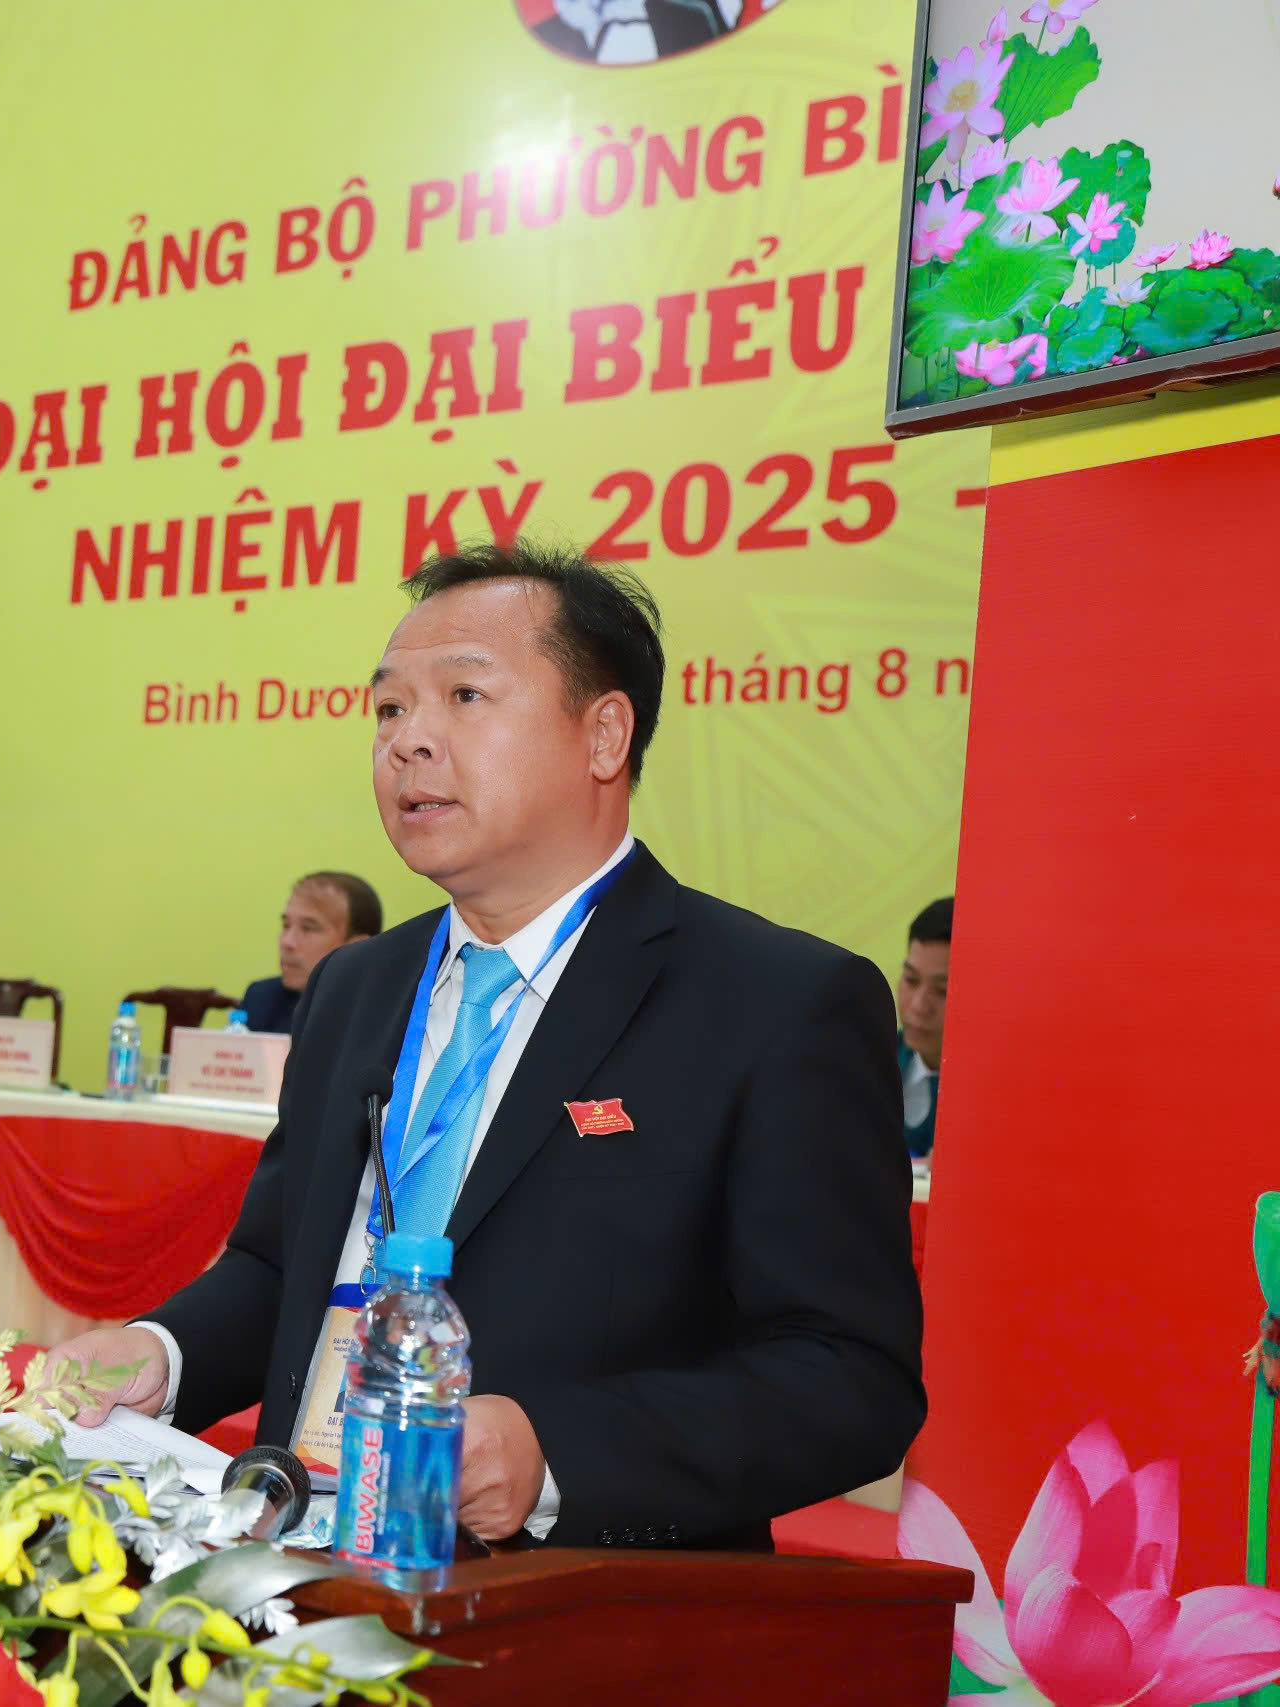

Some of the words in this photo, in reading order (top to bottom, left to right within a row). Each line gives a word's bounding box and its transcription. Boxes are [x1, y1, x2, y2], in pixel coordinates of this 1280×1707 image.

[69, 214, 248, 312] ĐẢNG
[275, 176, 376, 280] BỘ
[405, 114, 767, 252] PHƯỜNG
[803, 64, 903, 178] BÌ
[134, 340, 309, 469] HỘI
[338, 319, 528, 444] ĐẠI
[563, 235, 867, 405] BIỂU
[69, 486, 363, 613] NHIỆM
[401, 458, 544, 578] KỲ
[584, 444, 898, 565] 2025
[144, 681, 239, 725] Bình
[257, 678, 372, 721] Dươ
[681, 652, 851, 715] tháng
[875, 647, 908, 699] 8
[355, 1427, 383, 1553] BIWASE
